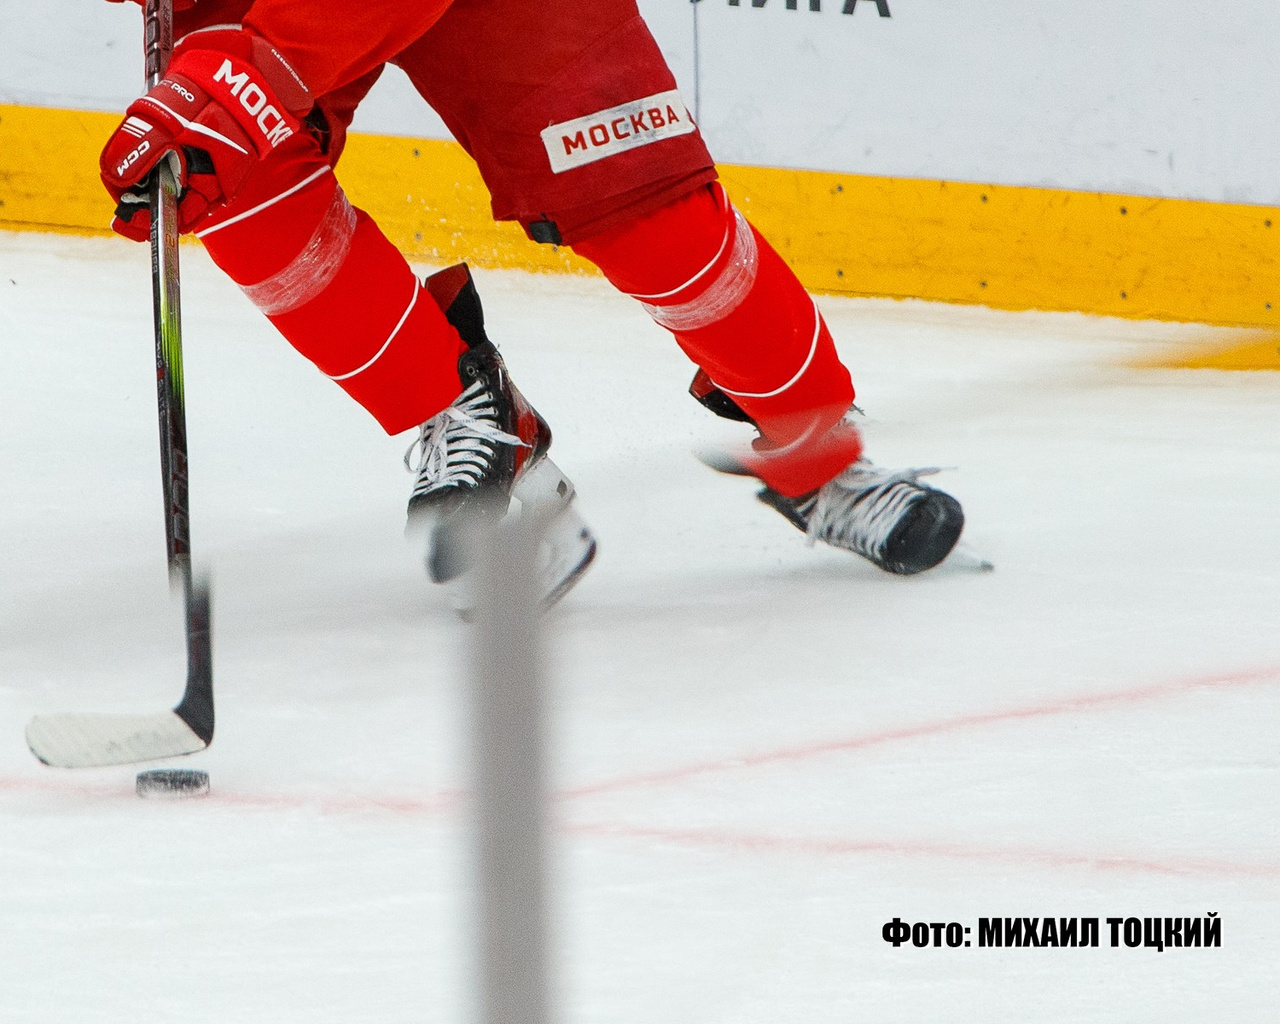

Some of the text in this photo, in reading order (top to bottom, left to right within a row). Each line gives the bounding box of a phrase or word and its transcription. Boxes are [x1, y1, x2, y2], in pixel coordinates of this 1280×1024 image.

[170, 82, 195, 103] PRO
[561, 104, 680, 156] МОСКВА
[116, 140, 151, 177] CCM
